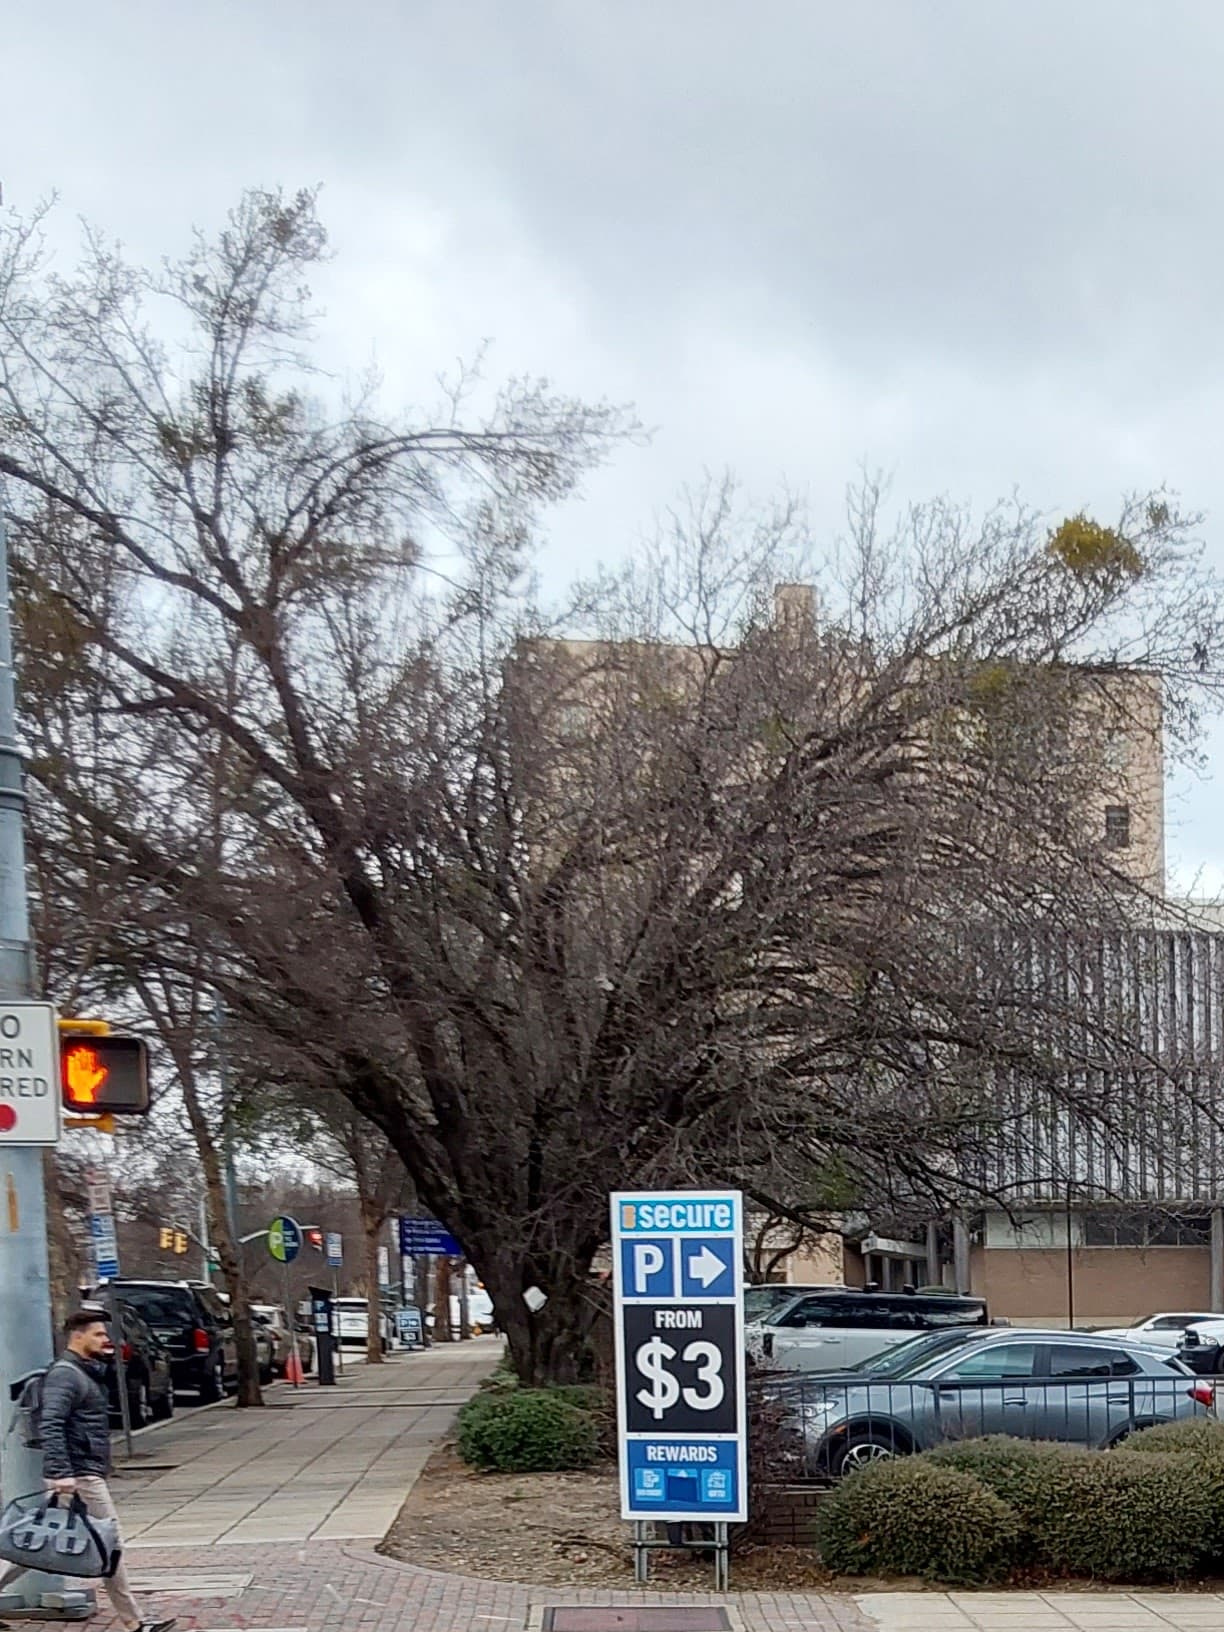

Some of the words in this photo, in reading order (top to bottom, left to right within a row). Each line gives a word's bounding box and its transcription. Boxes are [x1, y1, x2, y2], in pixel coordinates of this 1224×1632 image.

[0, 1014, 21, 1039] O
[0, 1048, 33, 1068] RN
[0, 1077, 48, 1097] RED
[639, 1202, 731, 1229] secure
[634, 1244, 664, 1293] P
[655, 1310, 702, 1329] FROM
[636, 1336, 725, 1420] $3
[647, 1445, 718, 1463] REWARDS
